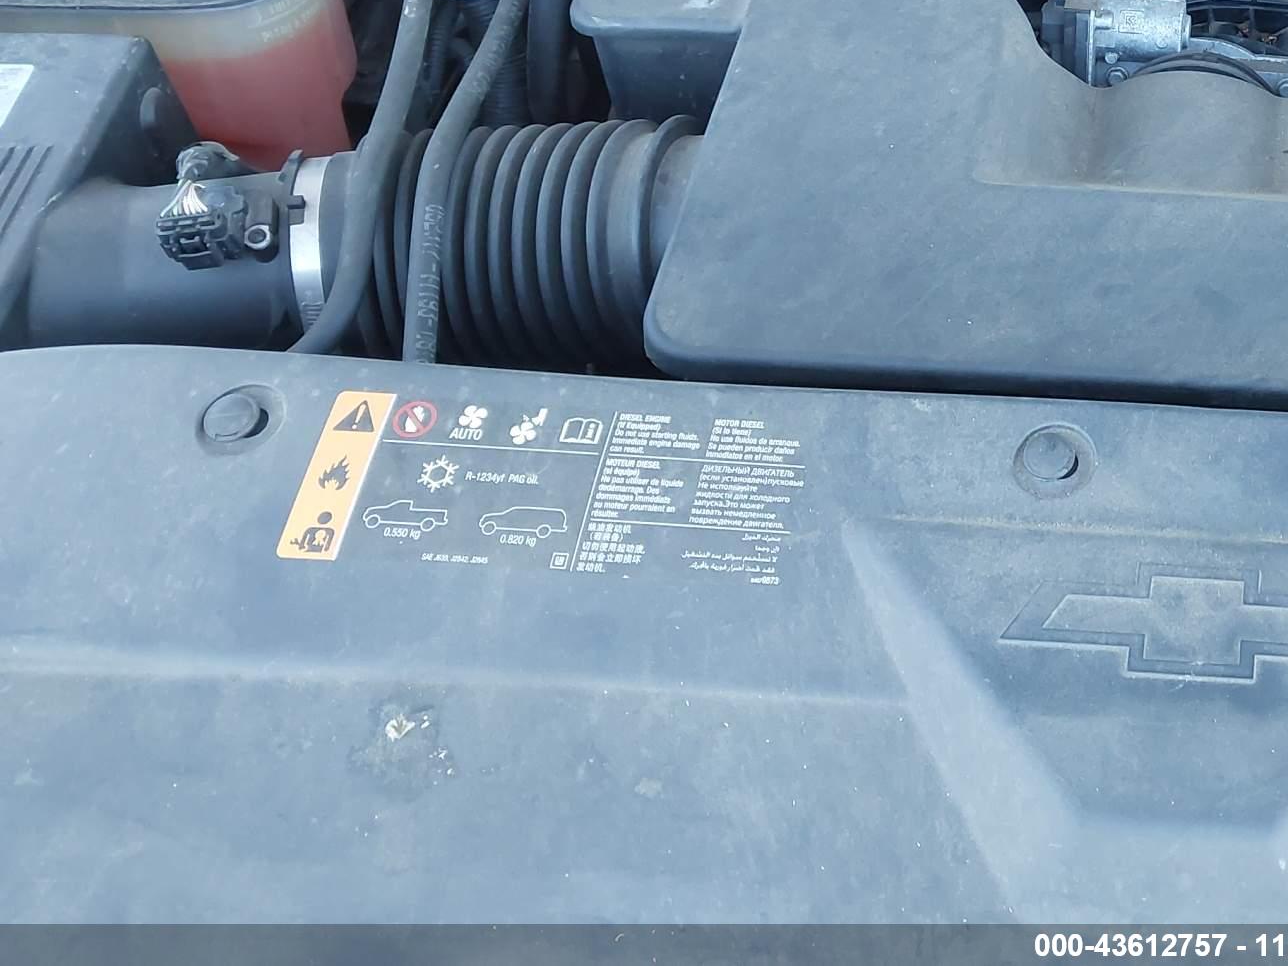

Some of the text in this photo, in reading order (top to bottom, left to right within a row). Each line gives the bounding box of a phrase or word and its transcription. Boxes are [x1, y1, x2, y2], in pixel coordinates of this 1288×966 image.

[619, 413, 672, 423] DIESEL ENGINE
[714, 418, 765, 429] MOTOR DIESEL
[626, 422, 661, 432] Equipped)
[449, 427, 482, 441] AUTO
[615, 428, 625, 436] Do
[651, 431, 677, 440] starting
[672, 441, 700, 450] damage
[707, 442, 717, 450] Se
[718, 443, 744, 452] pueden
[605, 458, 660, 469] MOTEUR DIESEL
[465, 471, 505, 484] R-1234yf
[507, 473, 524, 484] PAG
[383, 527, 422, 540] 0.550 kg
[500, 534, 538, 547] 0.820 kg
